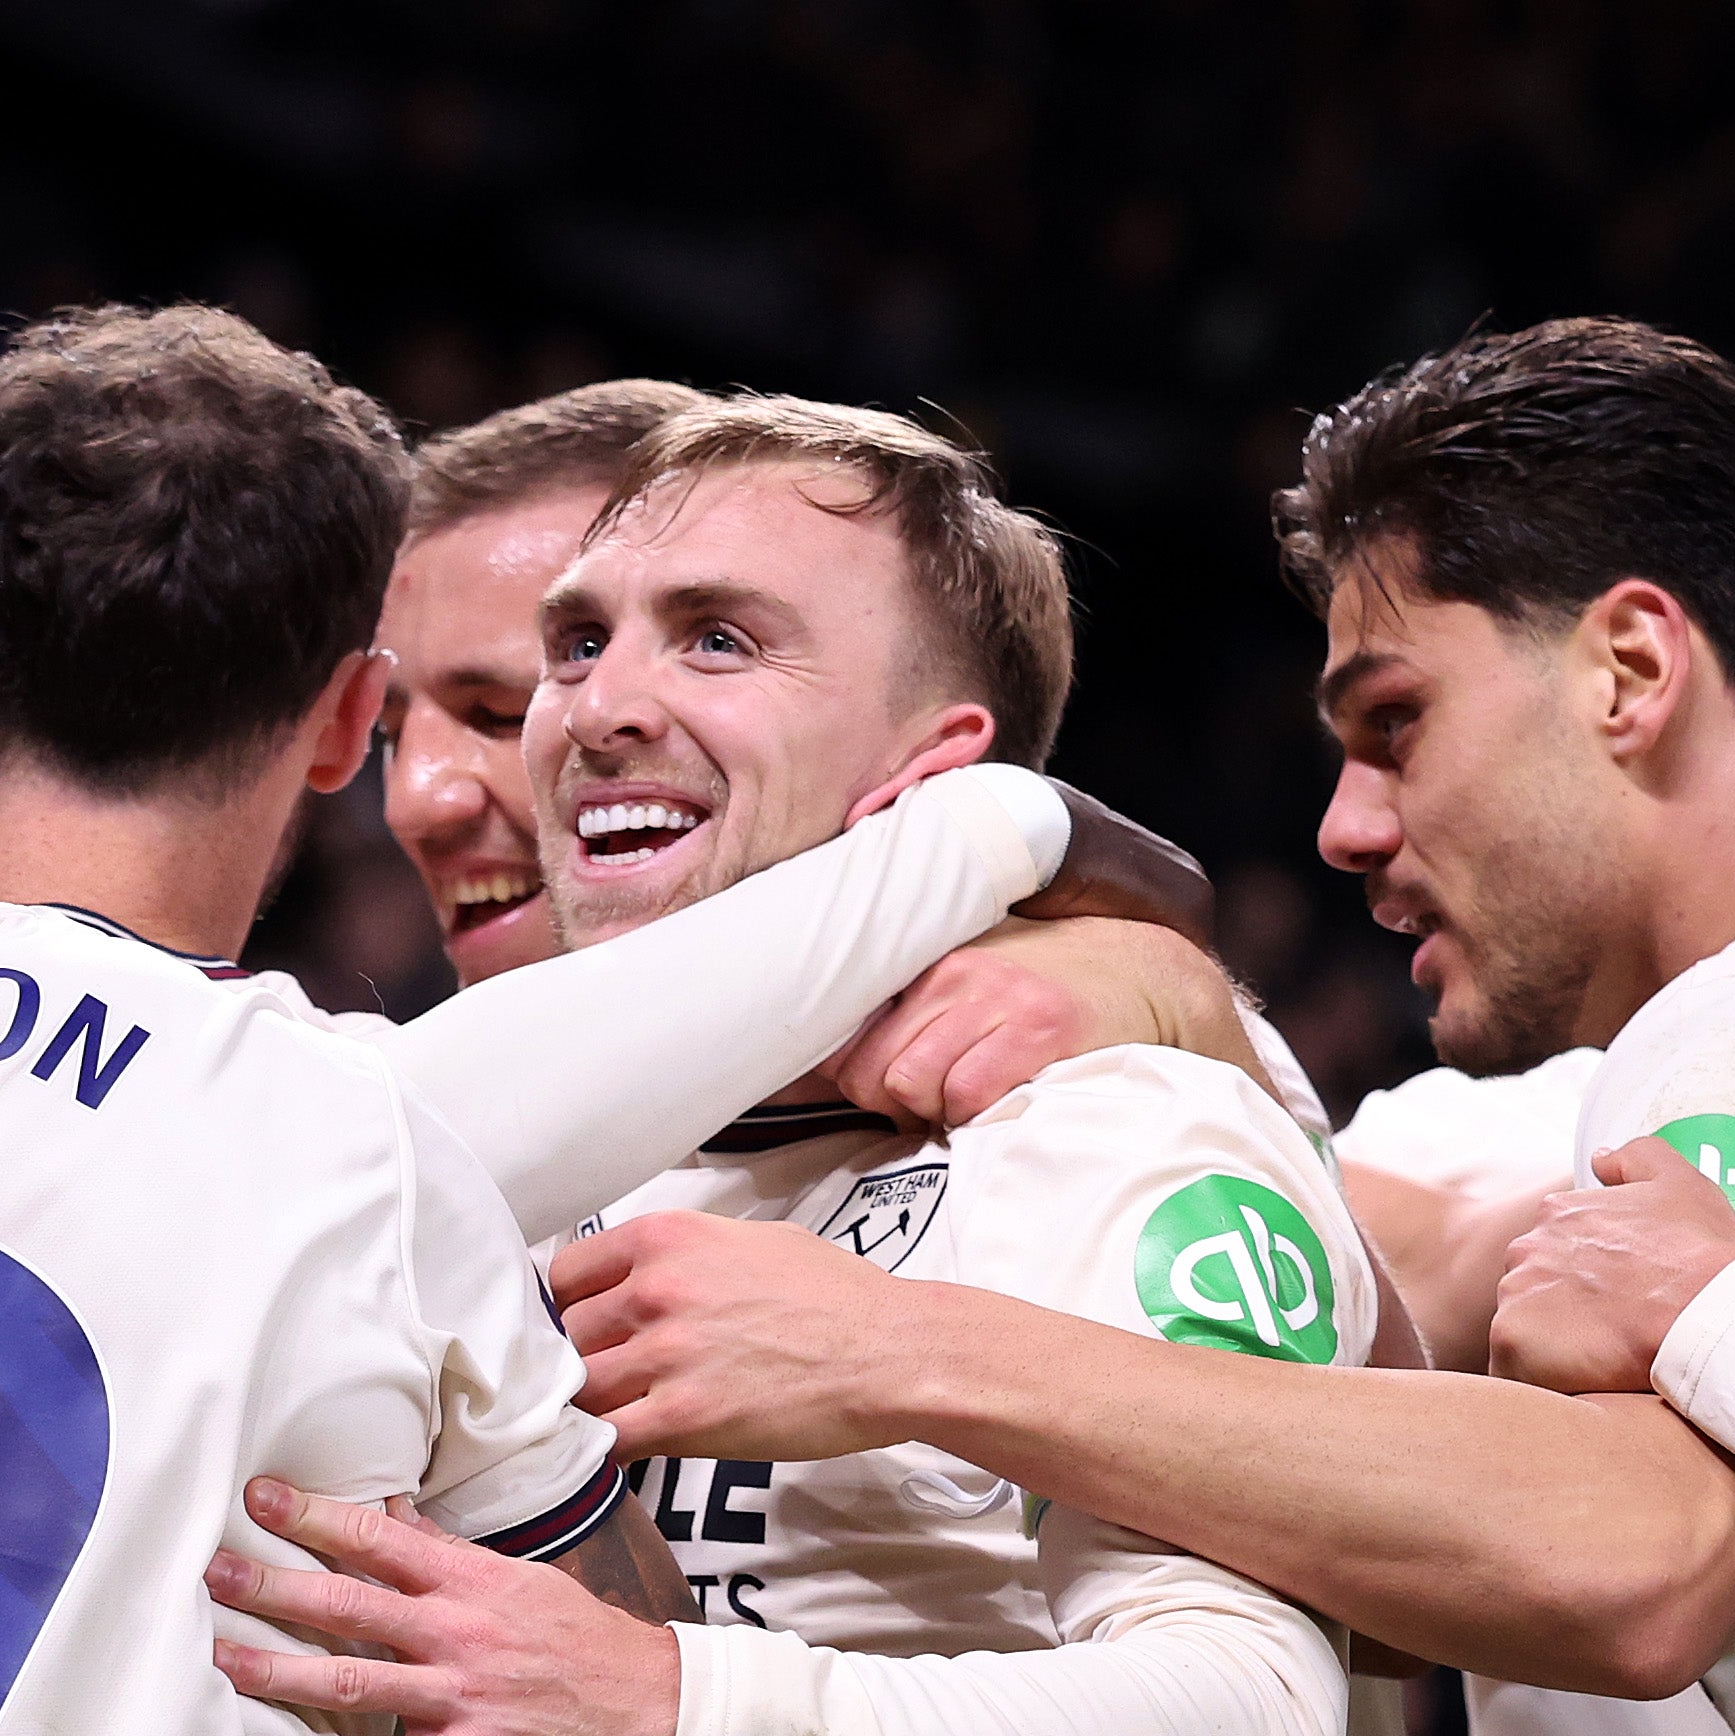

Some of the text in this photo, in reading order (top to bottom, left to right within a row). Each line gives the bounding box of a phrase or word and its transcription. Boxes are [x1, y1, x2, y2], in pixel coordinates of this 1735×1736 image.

[861, 1172, 941, 1199] WEST HAM
[870, 1191, 917, 1208] UNITED
